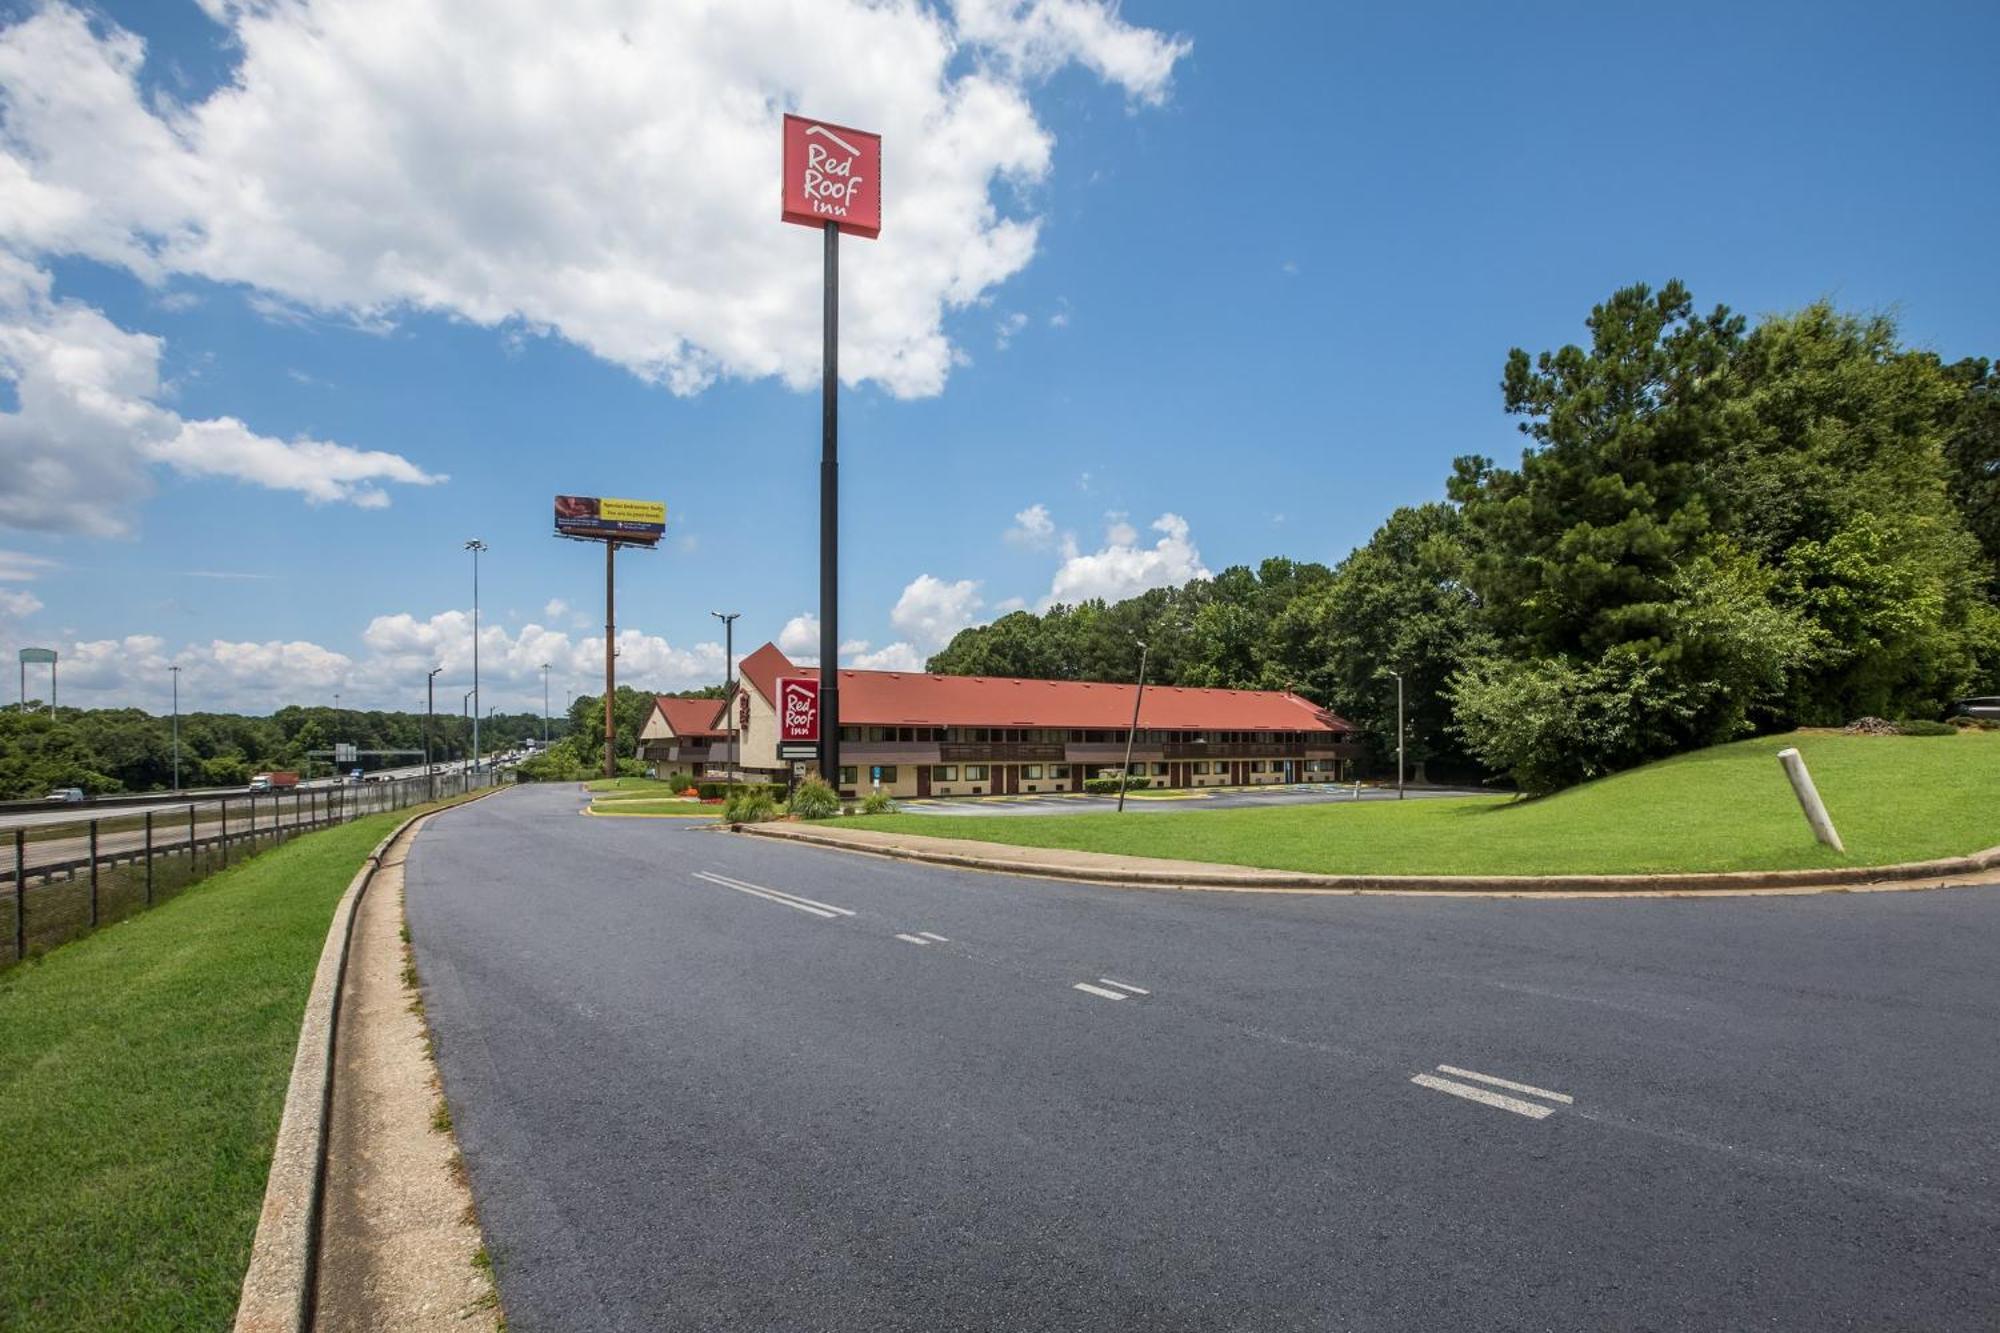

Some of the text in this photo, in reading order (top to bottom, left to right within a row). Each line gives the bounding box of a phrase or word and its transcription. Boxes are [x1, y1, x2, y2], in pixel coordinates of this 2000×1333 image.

[808, 143, 852, 176] Red
[804, 169, 863, 206] Roof
[788, 694, 811, 713] Red
[785, 709, 816, 728] Roof
